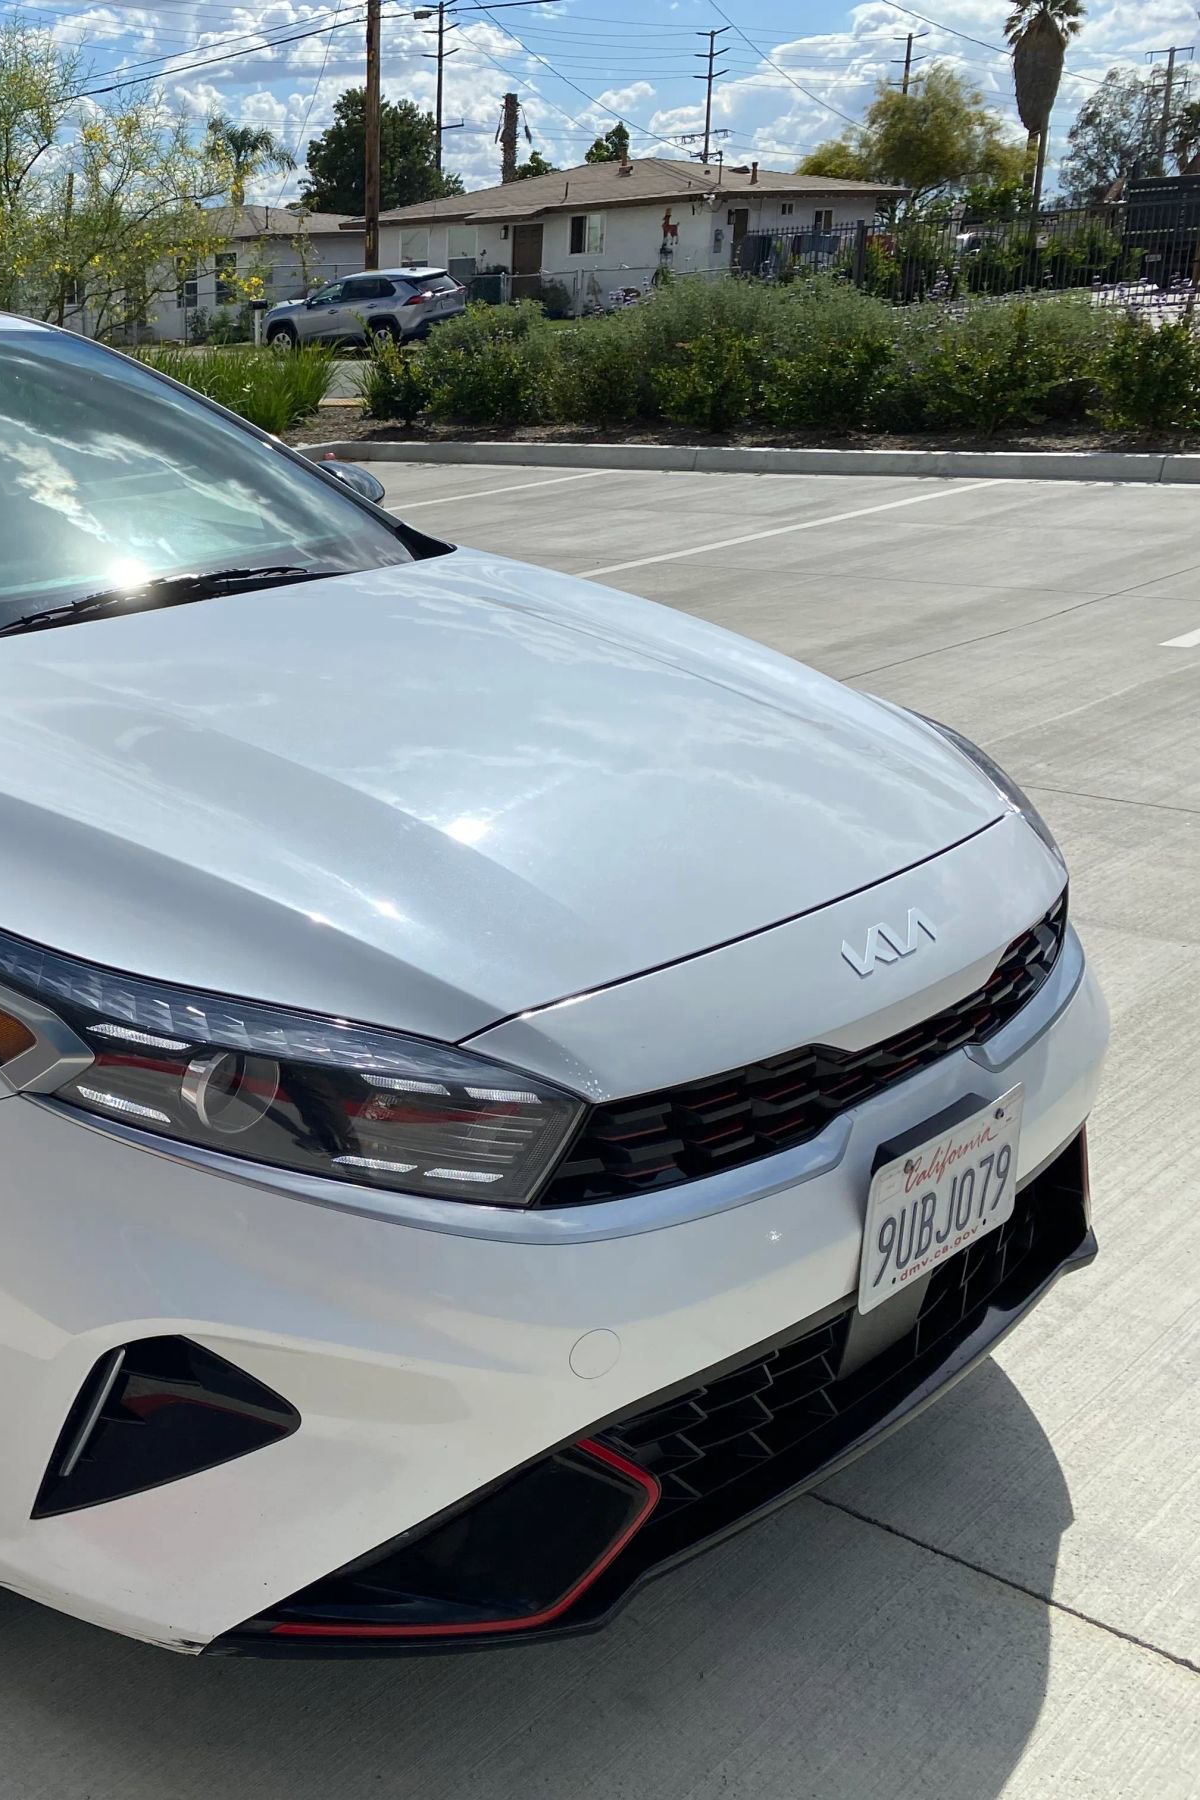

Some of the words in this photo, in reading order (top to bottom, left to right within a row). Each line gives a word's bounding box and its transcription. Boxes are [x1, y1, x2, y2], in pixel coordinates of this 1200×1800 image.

[841, 907, 936, 979] KIA
[904, 1127, 998, 1193] California
[872, 1144, 1011, 1288] 9UBJ079
[900, 1225, 979, 1281] dmv.ca.gov
